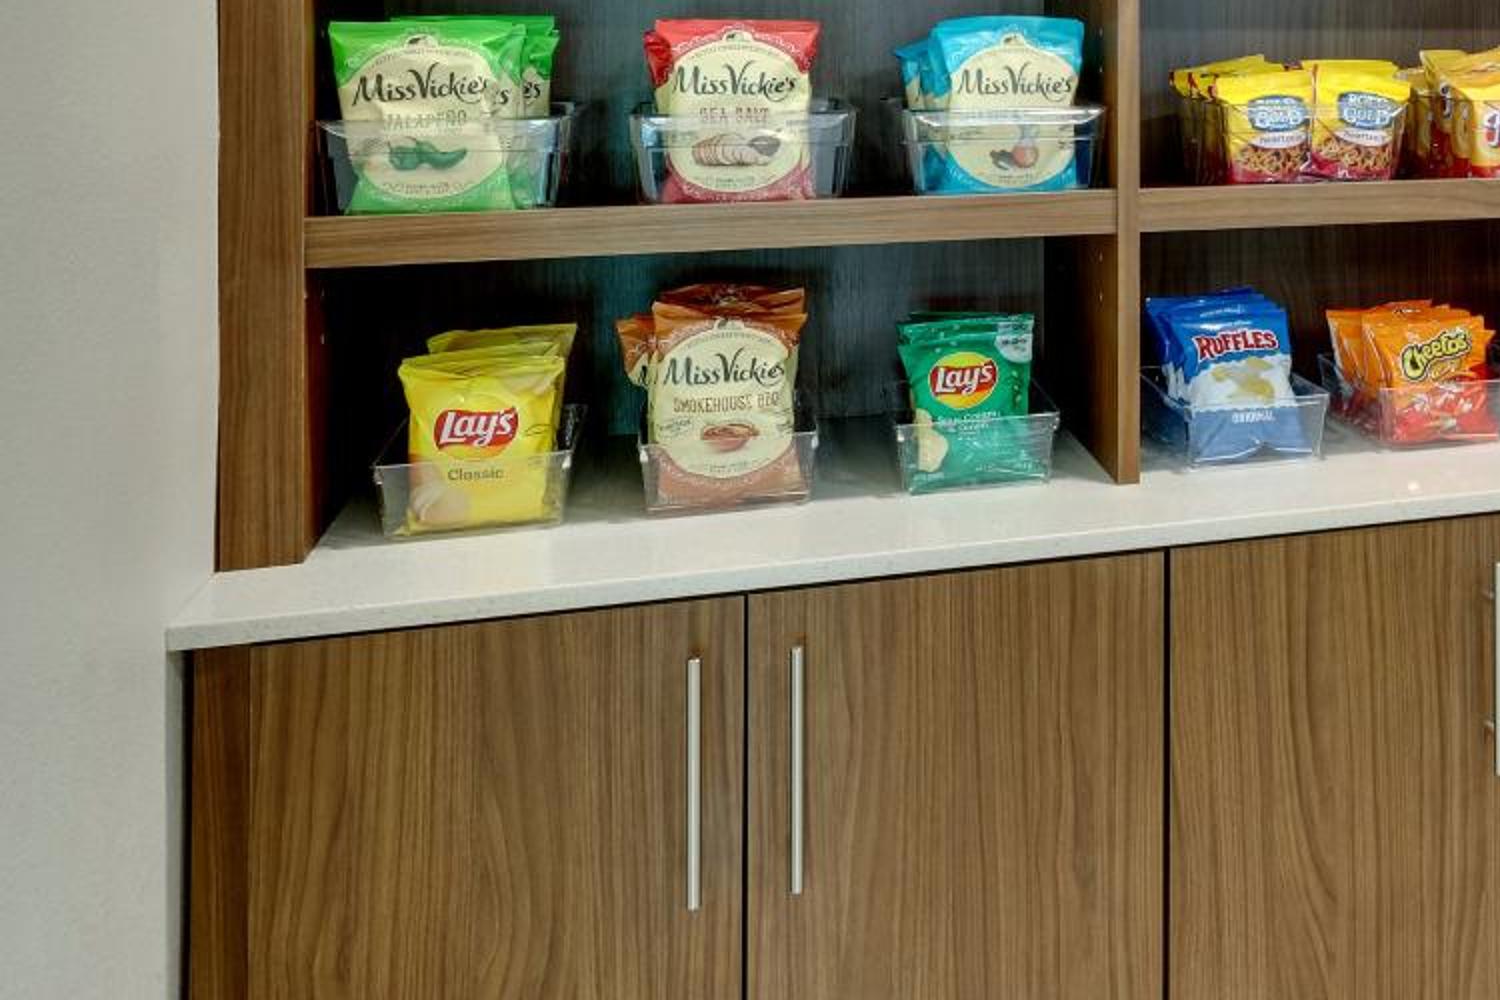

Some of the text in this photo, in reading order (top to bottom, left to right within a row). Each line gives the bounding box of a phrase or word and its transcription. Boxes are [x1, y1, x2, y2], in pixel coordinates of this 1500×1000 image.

[352, 72, 415, 106] Miss
[408, 62, 487, 104] Vickie's
[672, 60, 797, 102] Miss Vickie's
[957, 61, 1073, 103] Miss Vickie's
[1193, 329, 1280, 361] RUFFLES
[1402, 331, 1472, 382] Cheetos
[663, 357, 719, 386] Miss
[935, 360, 994, 395] Lay's
[673, 393, 752, 413] SMOKEHOUSE
[440, 408, 515, 447] Lay's
[448, 468, 505, 482] Classic
